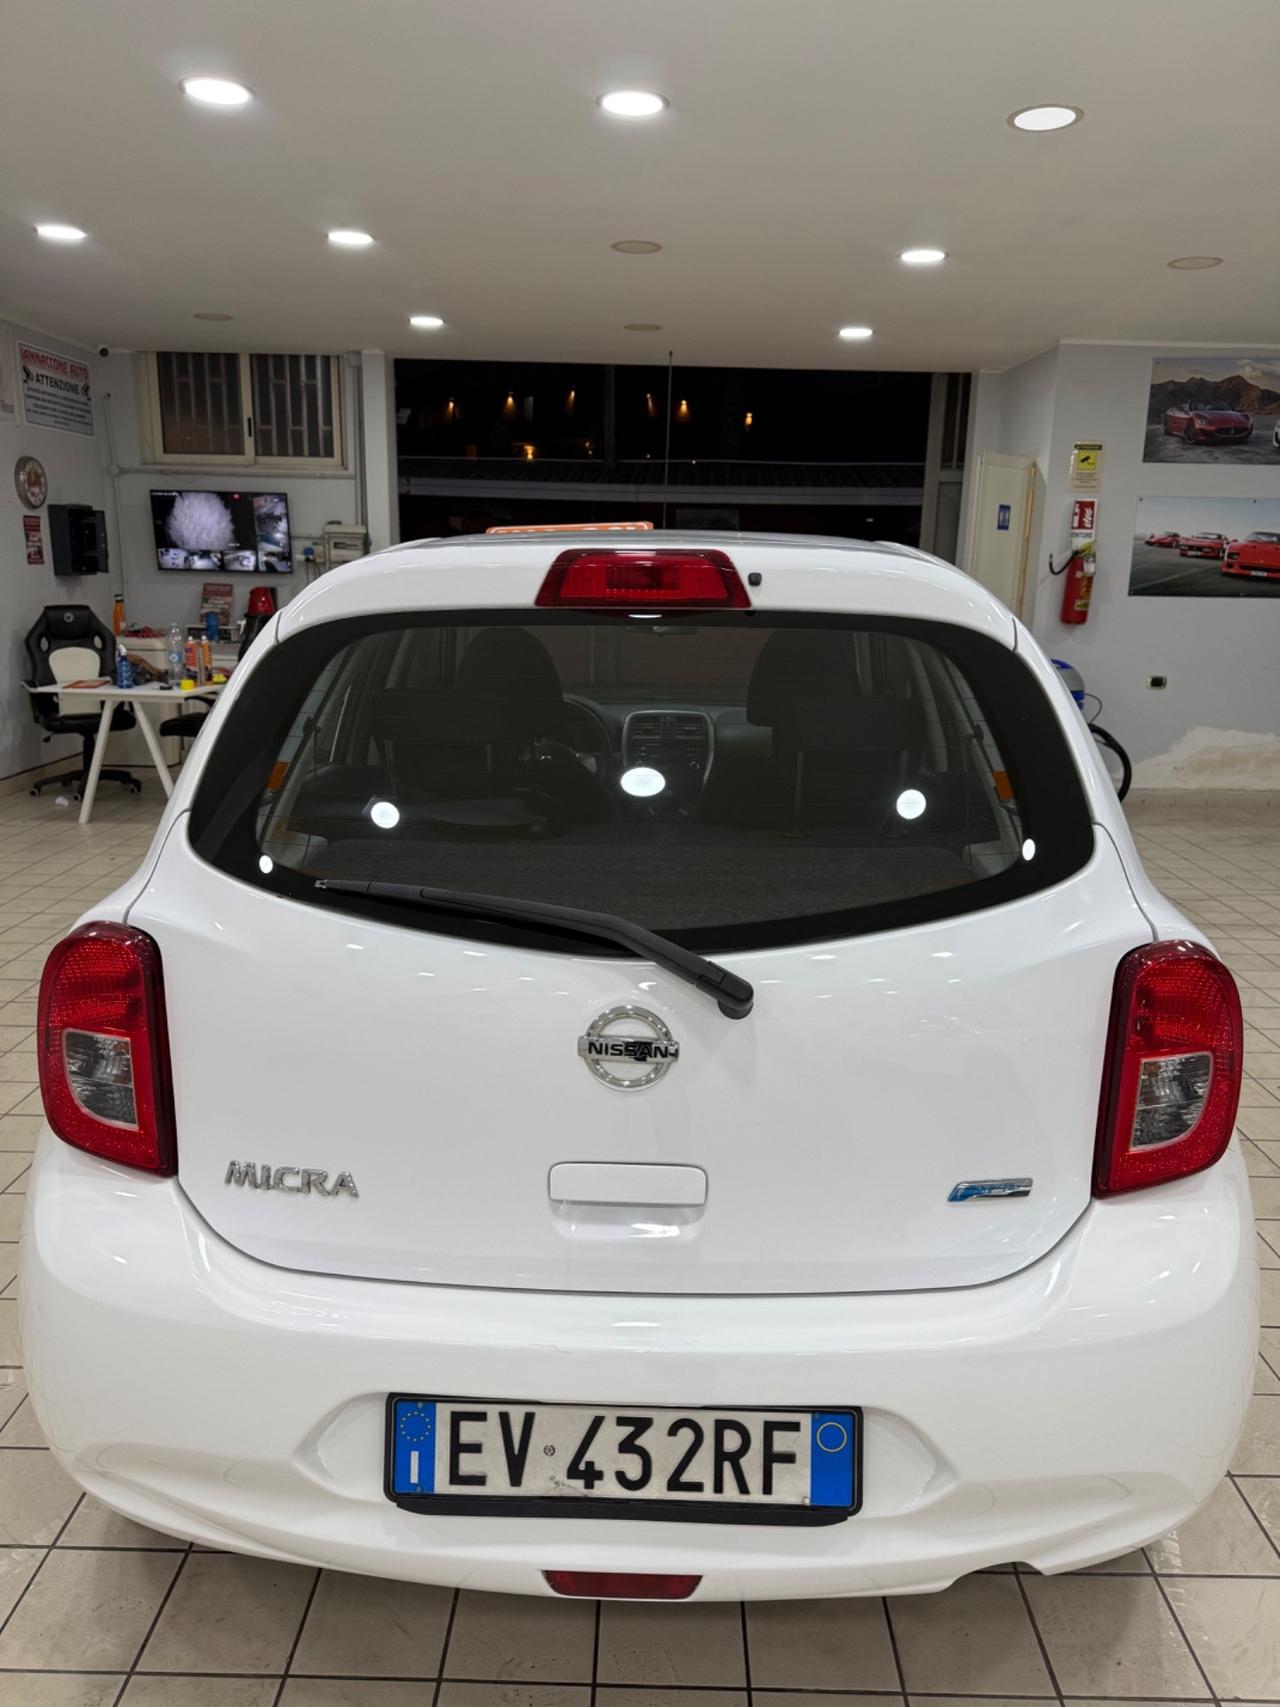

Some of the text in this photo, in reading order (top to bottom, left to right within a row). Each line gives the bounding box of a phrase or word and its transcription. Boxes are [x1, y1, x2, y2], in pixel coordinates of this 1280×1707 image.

[69, 364, 89, 381] AUTO
[35, 373, 80, 395] ATTENZIONE
[588, 1041, 669, 1059] NISSAN
[224, 1160, 360, 1199] MICRA
[449, 1411, 801, 1495] EV 432RF
